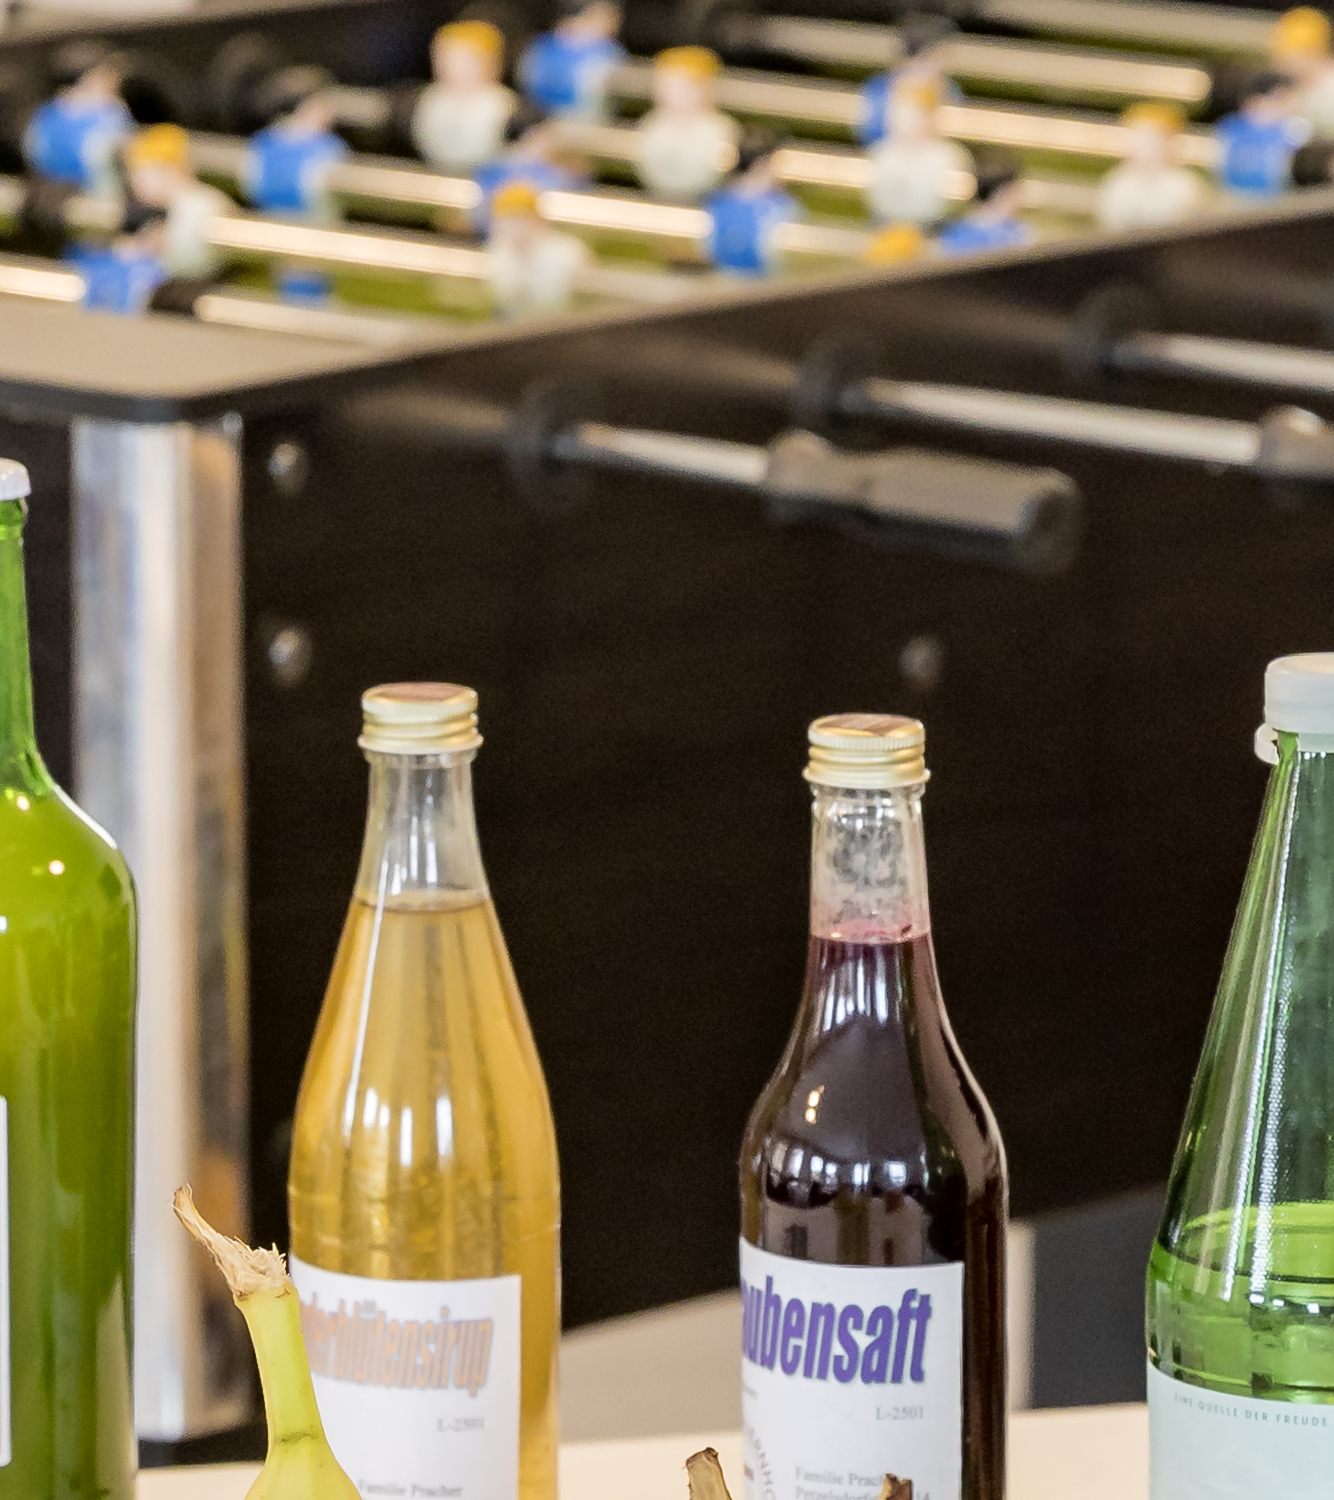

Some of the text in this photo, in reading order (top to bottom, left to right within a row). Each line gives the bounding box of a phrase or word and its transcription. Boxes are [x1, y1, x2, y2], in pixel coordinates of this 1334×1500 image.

[875, 1404, 925, 1421] L-2501
[1174, 1392, 1328, 1427] EINE QUELLE DER FREUDE
[794, 1466, 885, 1488] Familie Prac
